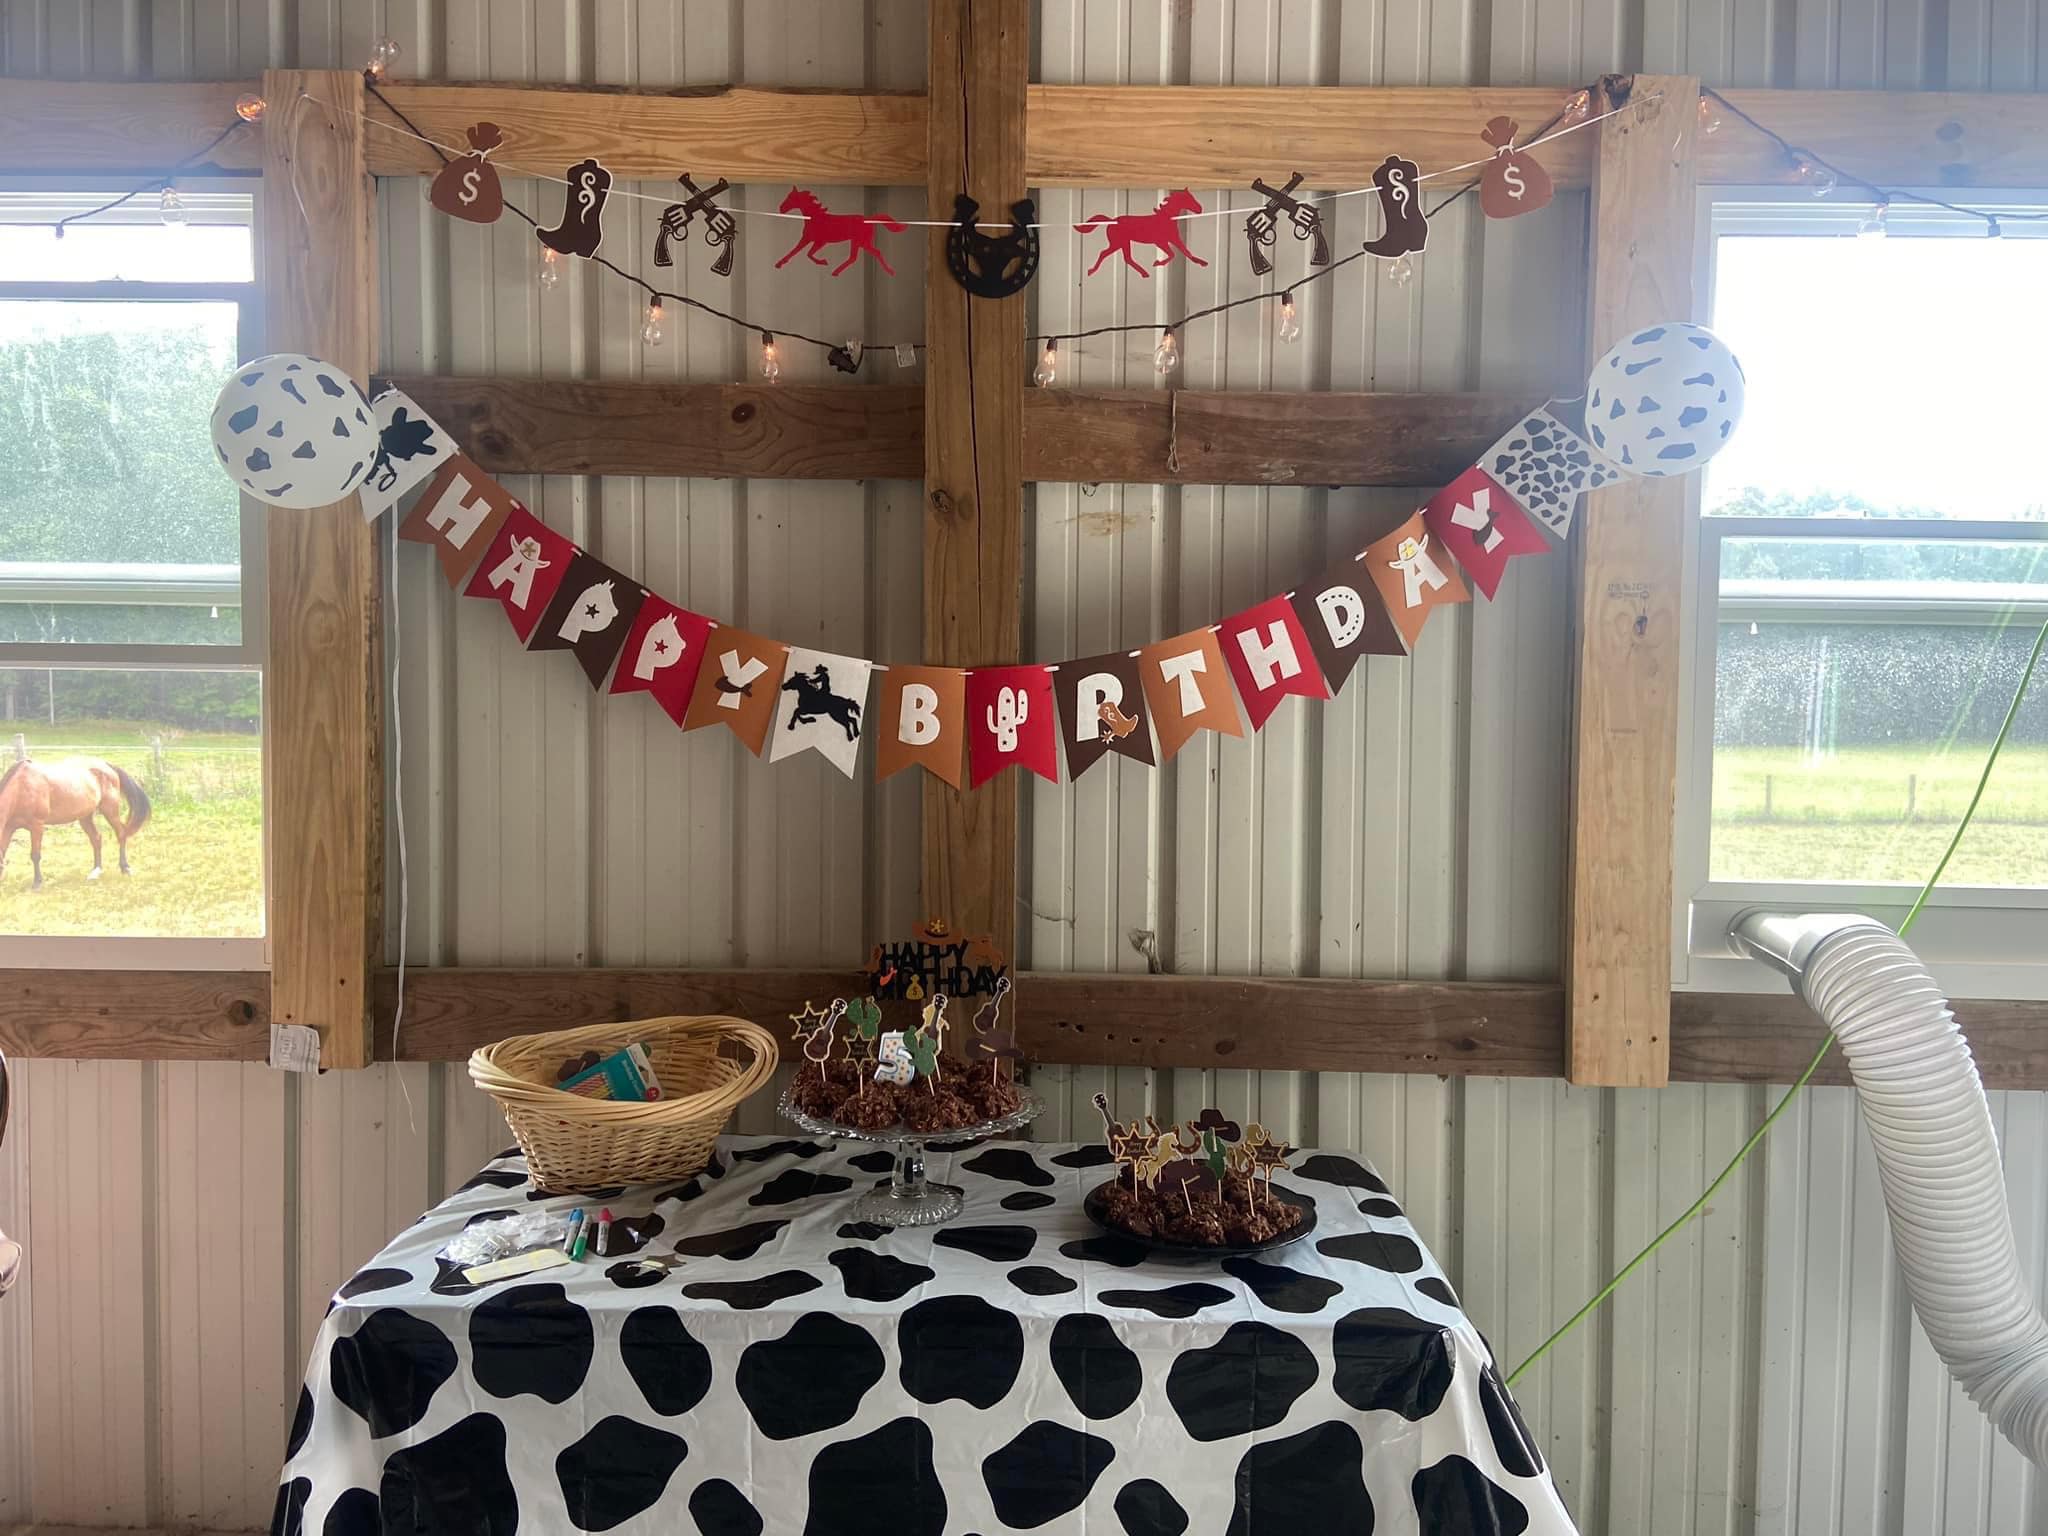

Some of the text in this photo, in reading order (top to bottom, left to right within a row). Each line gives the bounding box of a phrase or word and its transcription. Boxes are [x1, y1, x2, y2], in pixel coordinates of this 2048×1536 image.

[459, 168, 481, 206] $
[1503, 162, 1526, 200] $
[425, 472, 769, 710] HAPPY
[880, 939, 968, 970] HAPPY
[874, 1031, 916, 1086] 5
